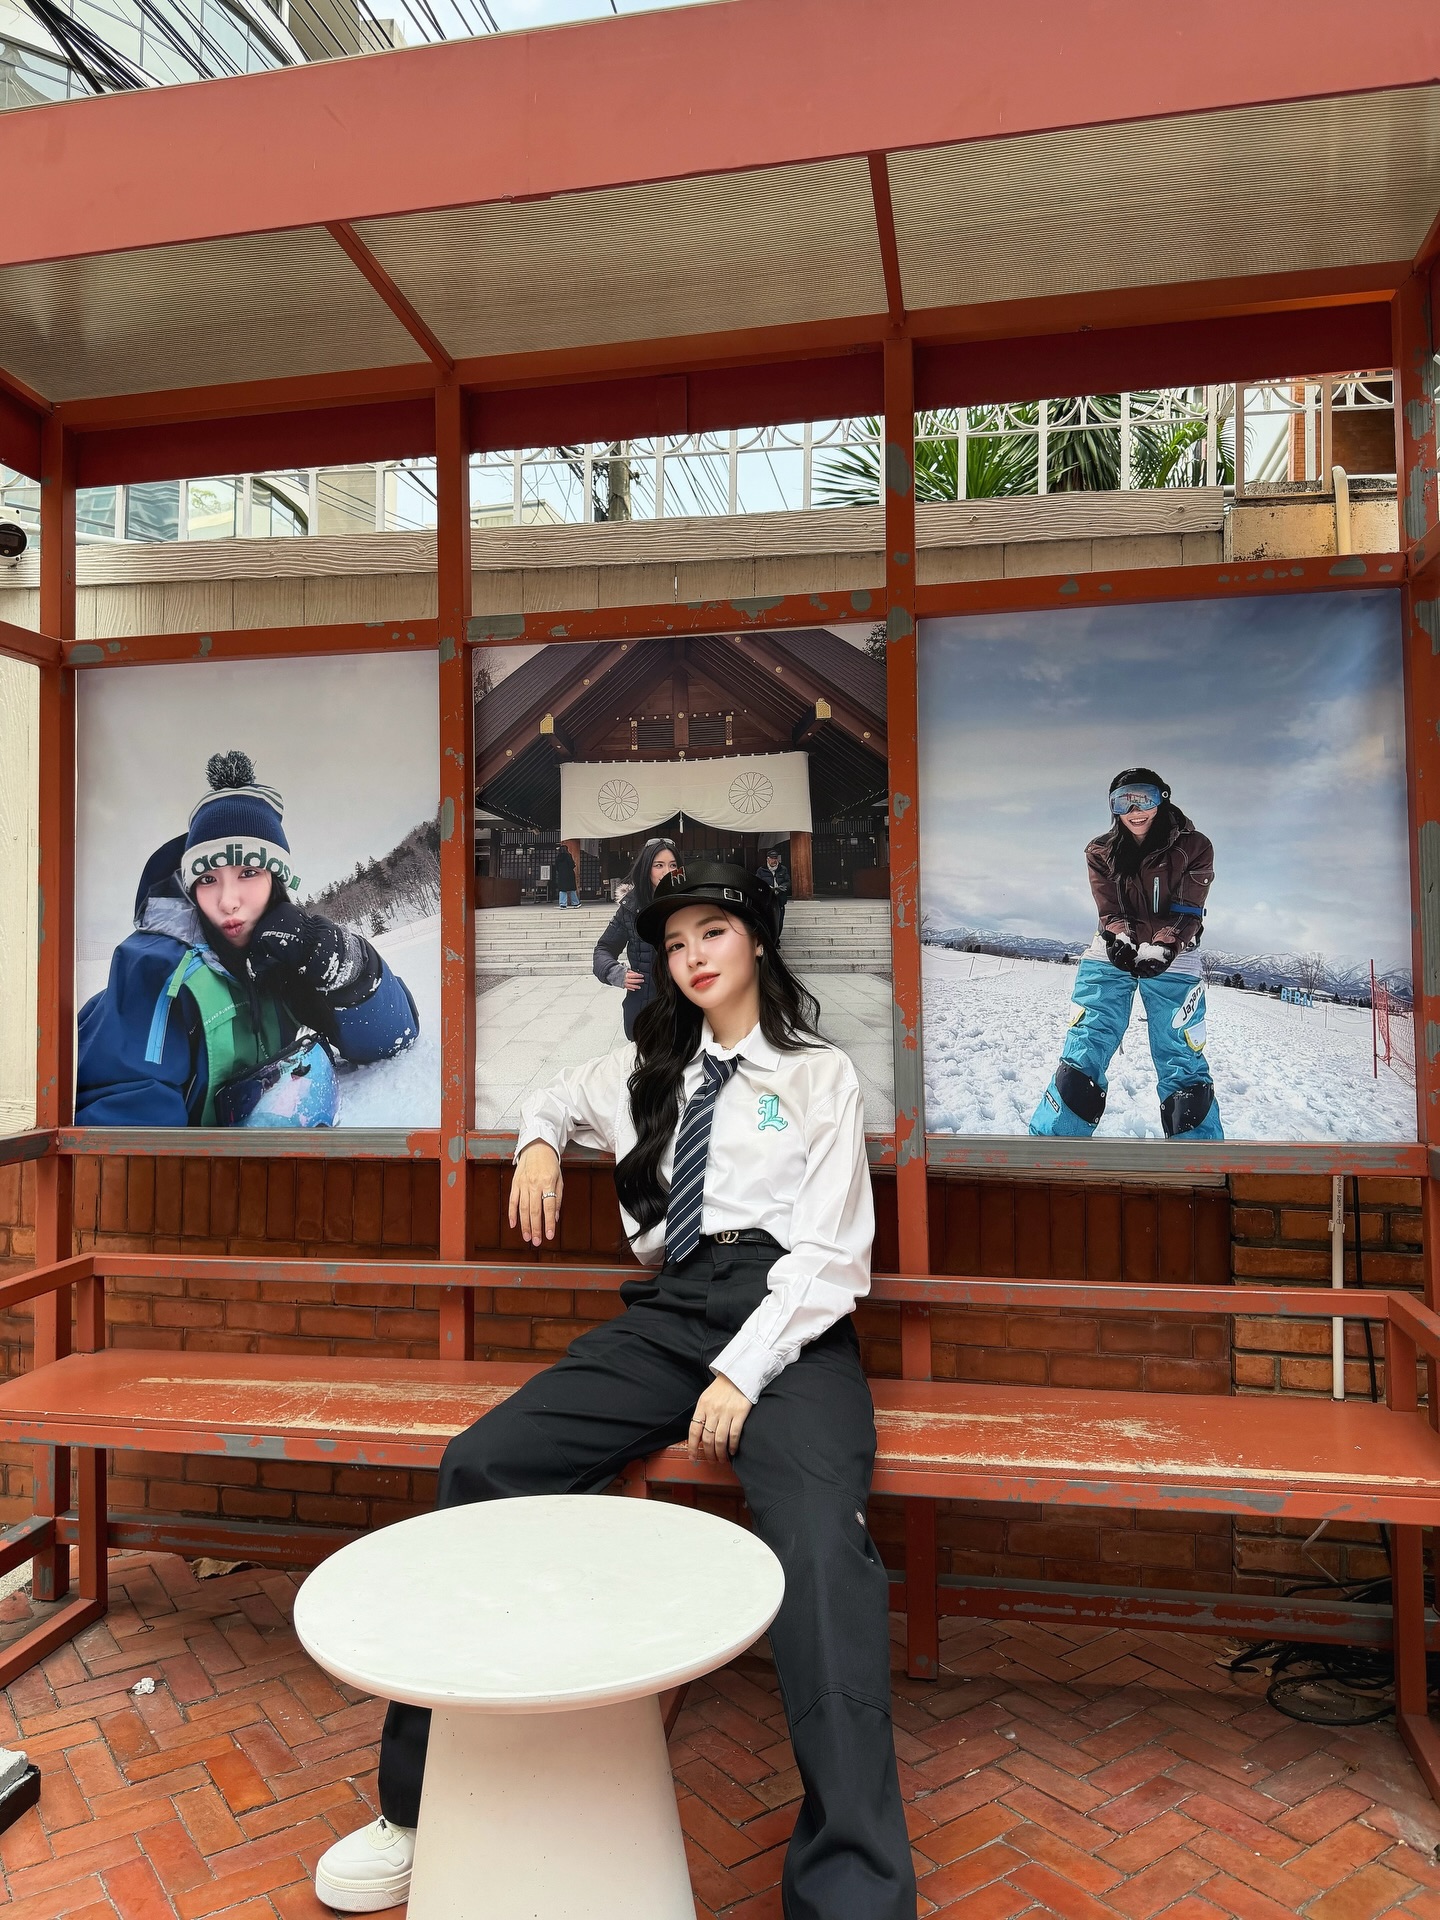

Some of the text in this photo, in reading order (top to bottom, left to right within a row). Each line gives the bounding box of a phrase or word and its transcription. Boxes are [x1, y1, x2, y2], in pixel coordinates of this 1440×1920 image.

[191, 844, 291, 882] adidas
[1182, 986, 1202, 1021] Japan
[757, 1093, 789, 1131] L
